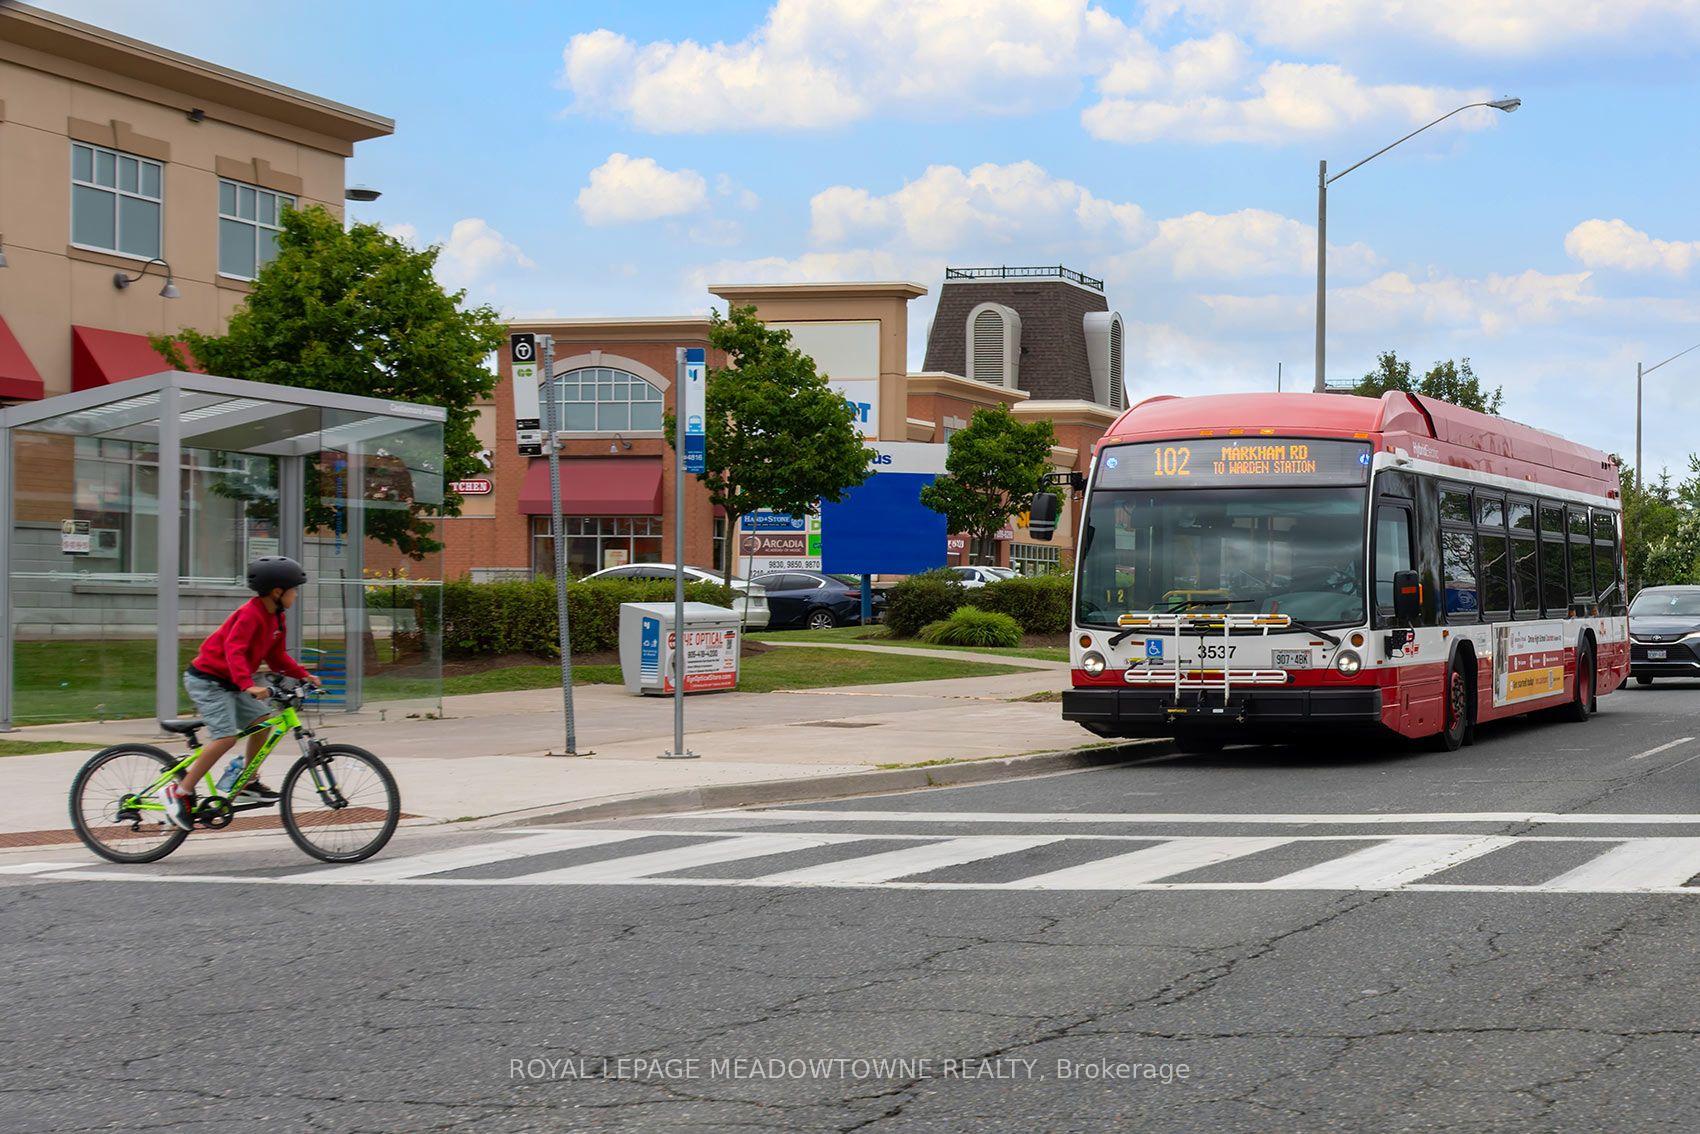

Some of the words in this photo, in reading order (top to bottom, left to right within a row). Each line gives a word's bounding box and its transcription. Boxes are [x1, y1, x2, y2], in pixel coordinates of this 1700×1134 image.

[1221, 445, 1285, 461] MARKHAM
[1290, 445, 1309, 460] RD
[872, 454, 892, 465] us
[1154, 447, 1191, 476] 102
[1213, 461, 1225, 475] TO
[1229, 461, 1269, 474] WARDEN
[1273, 460, 1316, 474] STATION
[448, 482, 487, 492] TCHEN
[768, 515, 790, 523] STONE
[762, 538, 804, 548] ARCADIA
[769, 560, 785, 569] 9830,
[786, 560, 803, 569] 9850,
[804, 560, 820, 568] 9870
[695, 632, 723, 645] OPTICAL
[1197, 645, 1237, 659] 3537
